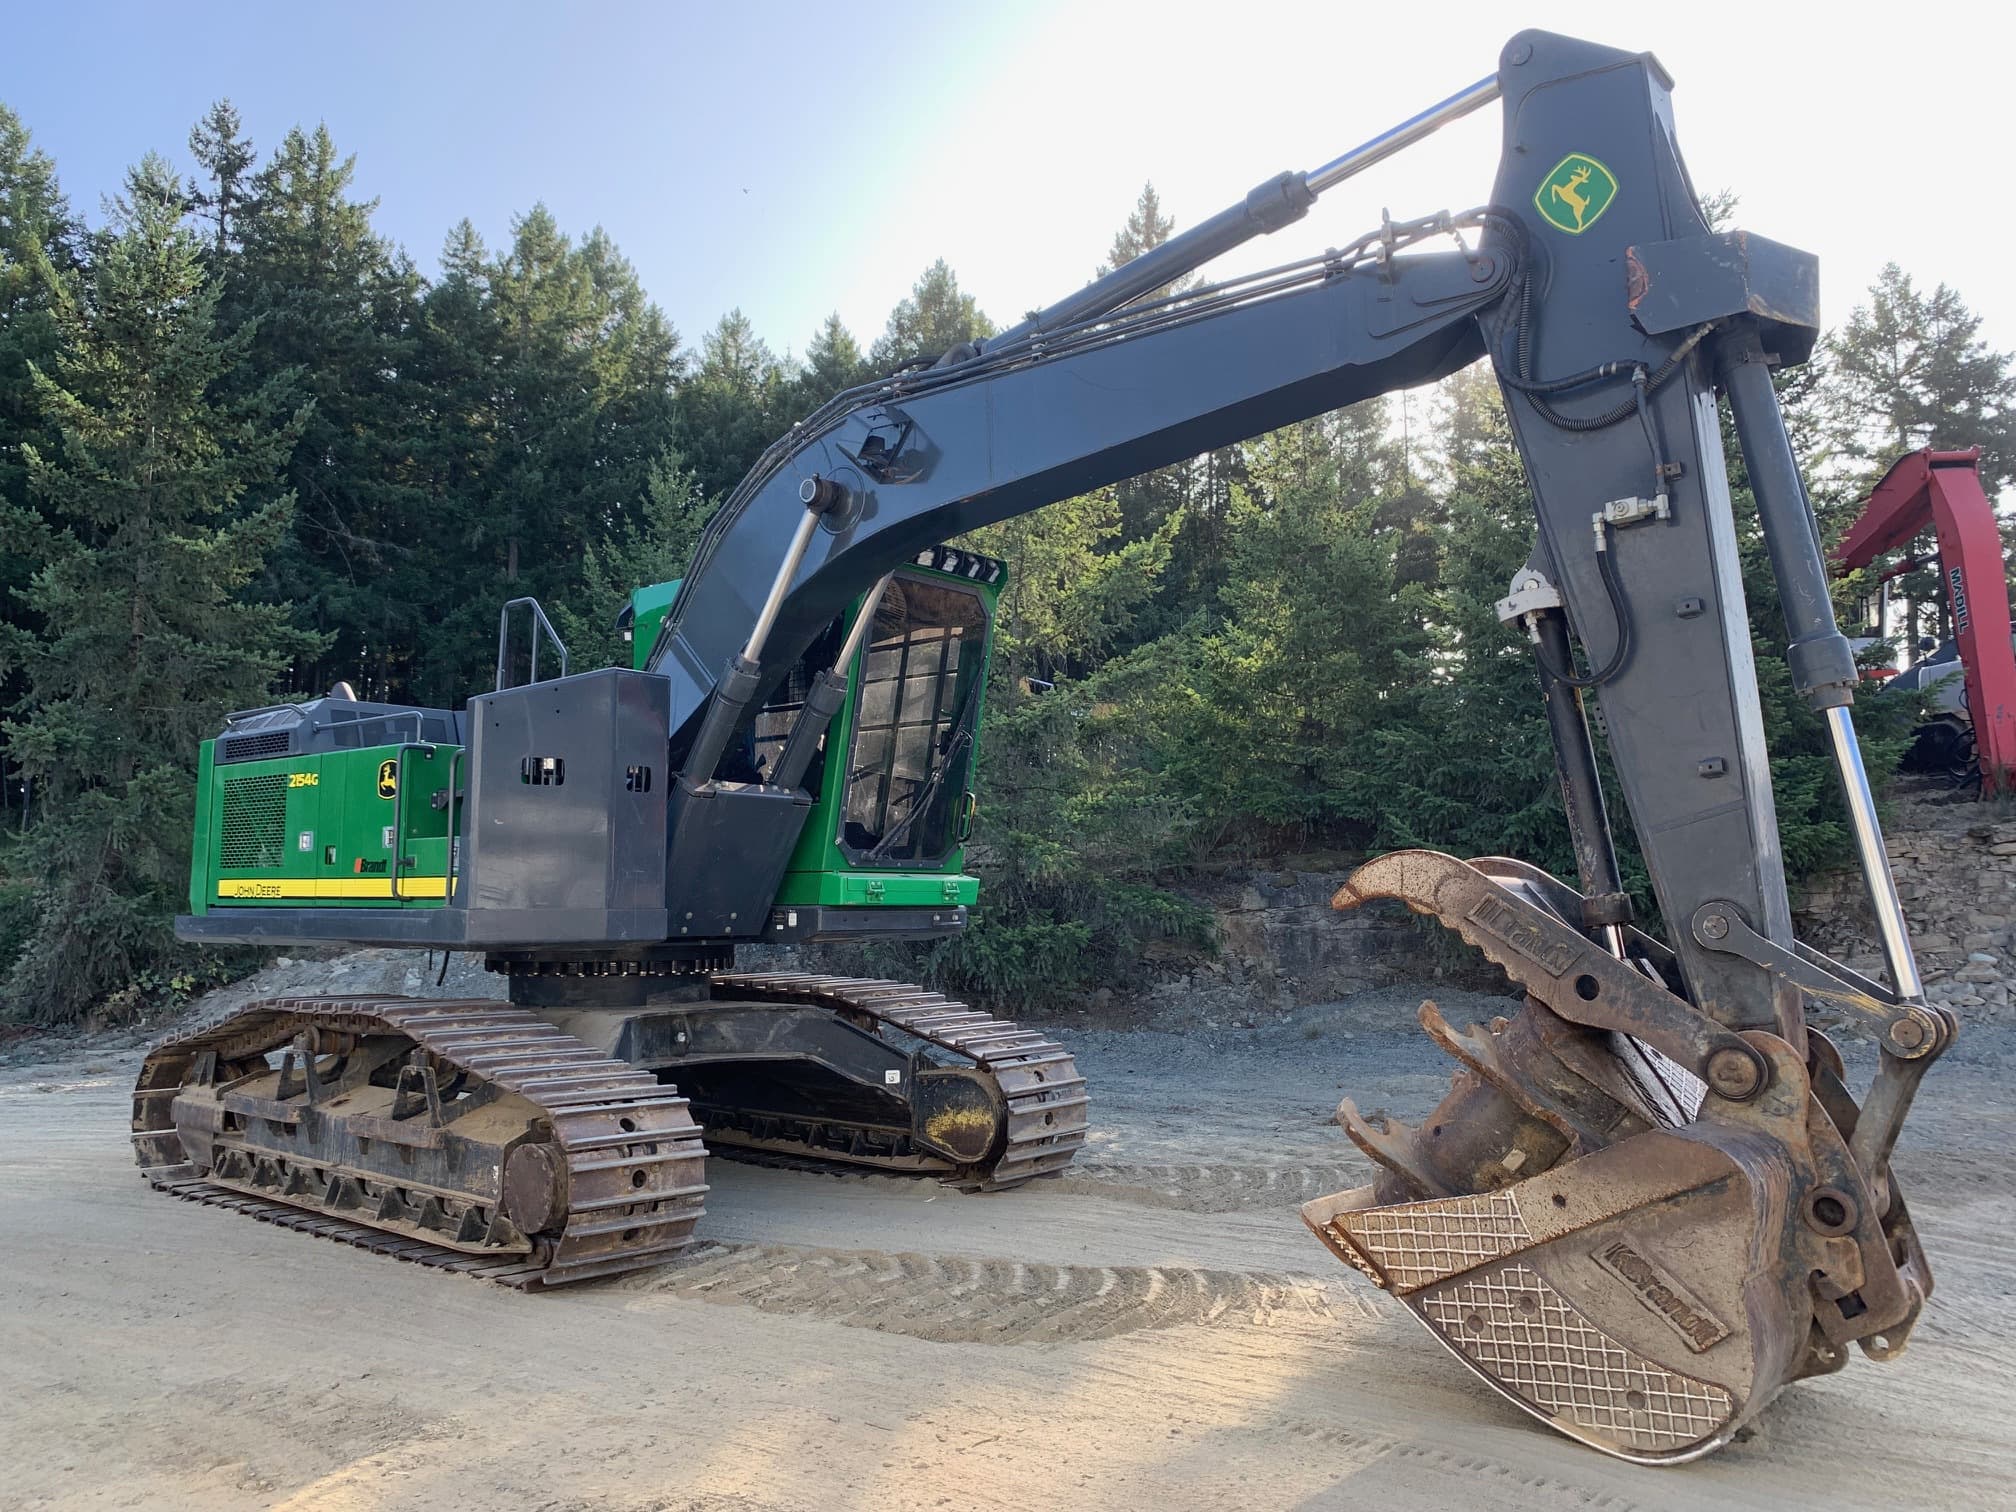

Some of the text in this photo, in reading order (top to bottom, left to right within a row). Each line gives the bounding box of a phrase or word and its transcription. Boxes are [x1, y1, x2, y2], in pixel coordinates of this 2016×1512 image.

[1949, 566, 1969, 635] MADILL
[289, 772, 319, 788] 2154G
[360, 858, 387, 873] Brandt
[233, 883, 281, 896] JOHN DEERE
